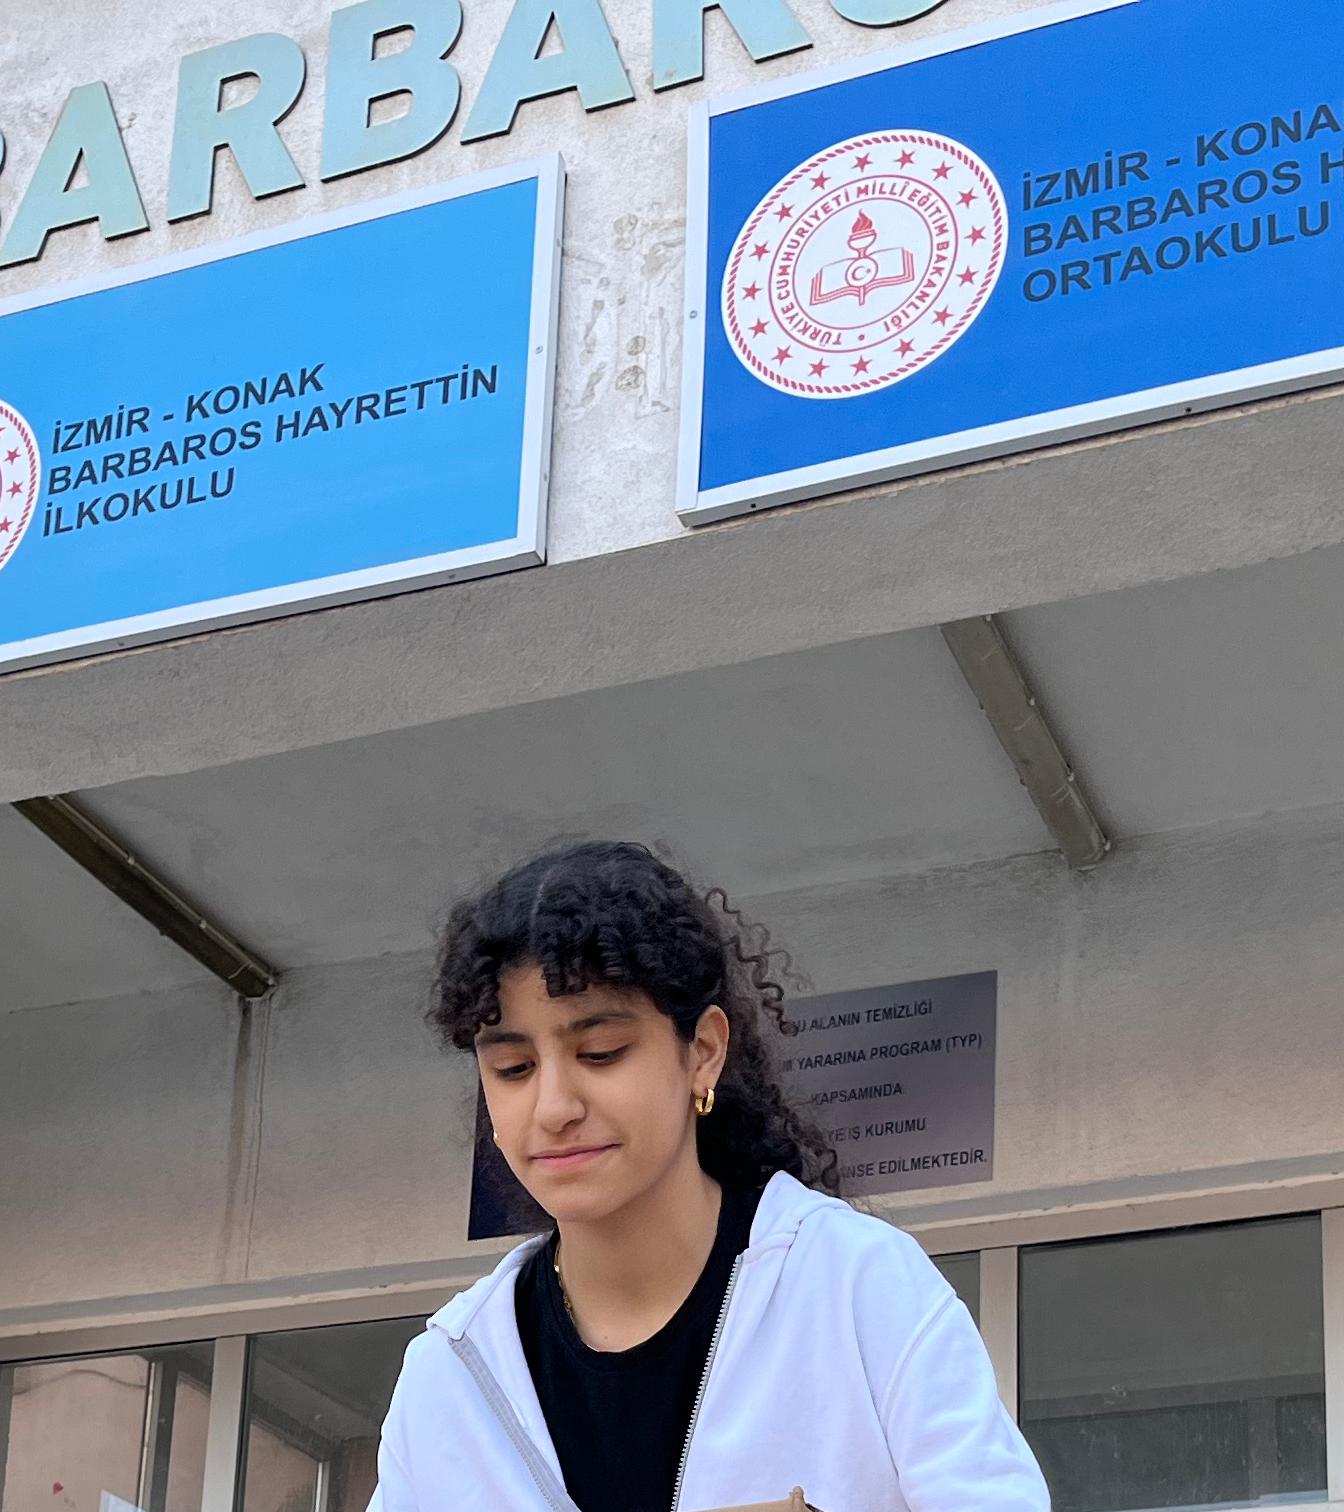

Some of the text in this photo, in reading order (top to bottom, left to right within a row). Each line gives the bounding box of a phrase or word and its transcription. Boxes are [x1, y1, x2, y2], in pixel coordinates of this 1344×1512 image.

[908, 188, 949, 236] EĞİTİM
[1022, 150, 1149, 211] İZMİR
[1023, 159, 1302, 257] BARBAROS
[776, 189, 850, 300] CUMHURİYETİ
[1022, 201, 1330, 302] ORTAOKULU
[884, 240, 950, 333] BAKANLIĞI
[781, 305, 843, 347] TÜRKİYE
[47, 363, 498, 495] BARBAROS HAYRETTİN
[52, 404, 151, 454] İZMİR
[186, 363, 325, 423] KONAK
[43, 467, 236, 537] İLKOKULU
[797, 1050, 866, 1069] YARARINA
[870, 1038, 941, 1059] PROGRAM
[946, 1033, 982, 1053] (TYP)
[809, 1012, 860, 1032] ALANIN
[865, 1118, 925, 1137] KURUMU
[879, 1148, 987, 1174] EDİLMEKTEDİR.
